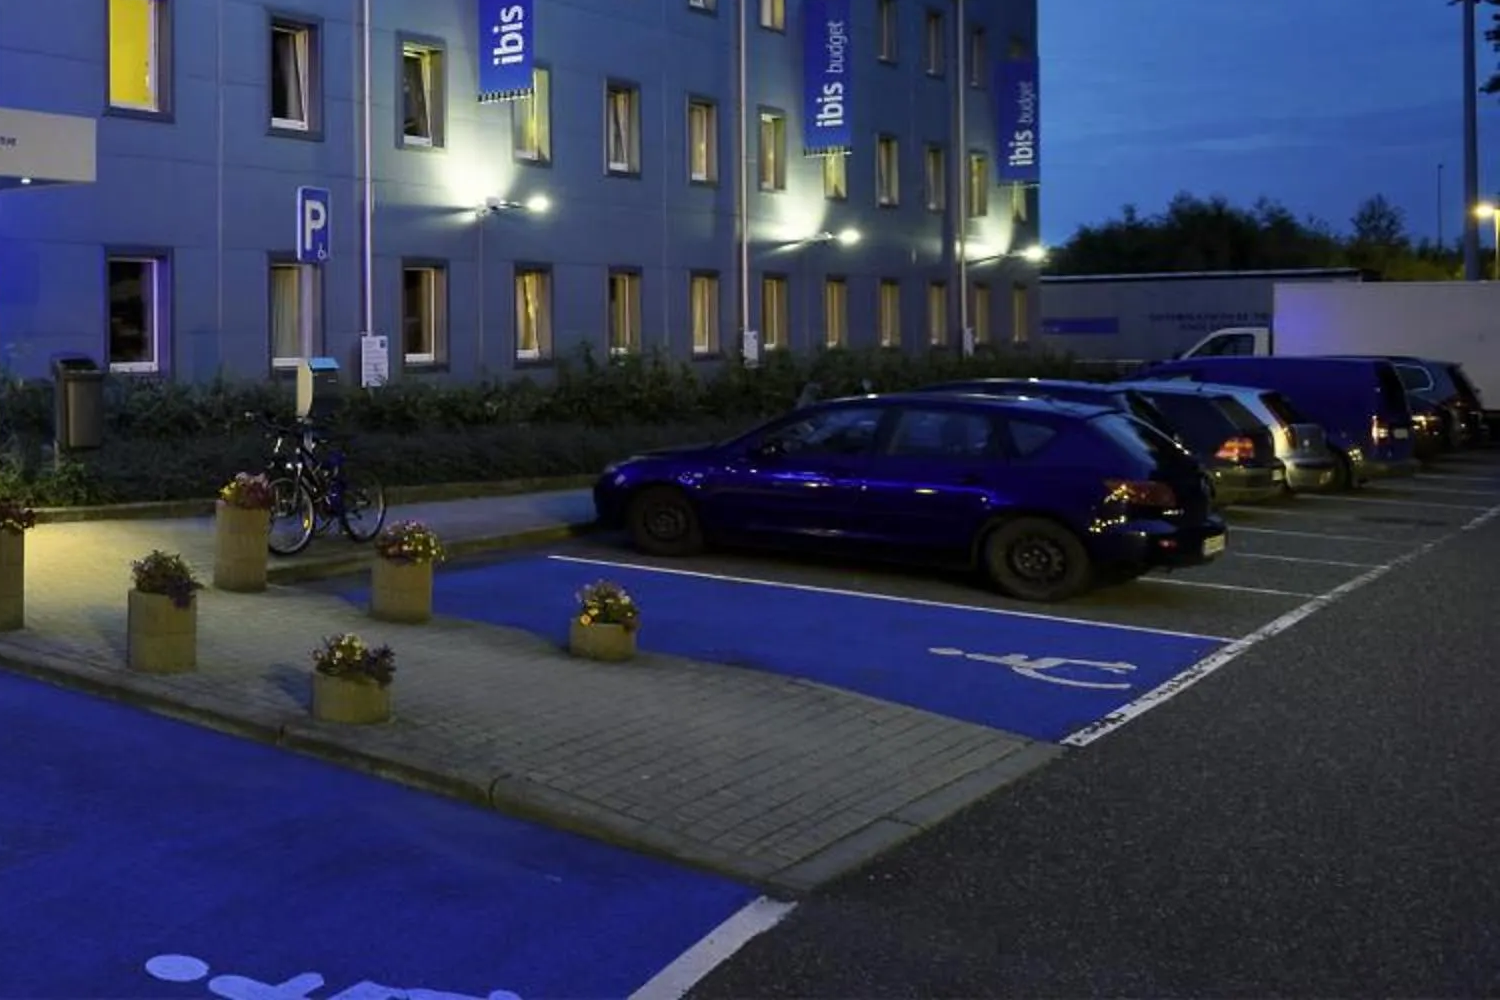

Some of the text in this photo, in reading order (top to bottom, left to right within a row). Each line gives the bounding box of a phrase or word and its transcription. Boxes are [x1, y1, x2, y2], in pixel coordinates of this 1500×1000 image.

[493, 4, 525, 66] ibis
[815, 20, 848, 128] ibis budget
[1008, 130, 1034, 166] ibis
[304, 199, 326, 251] P
